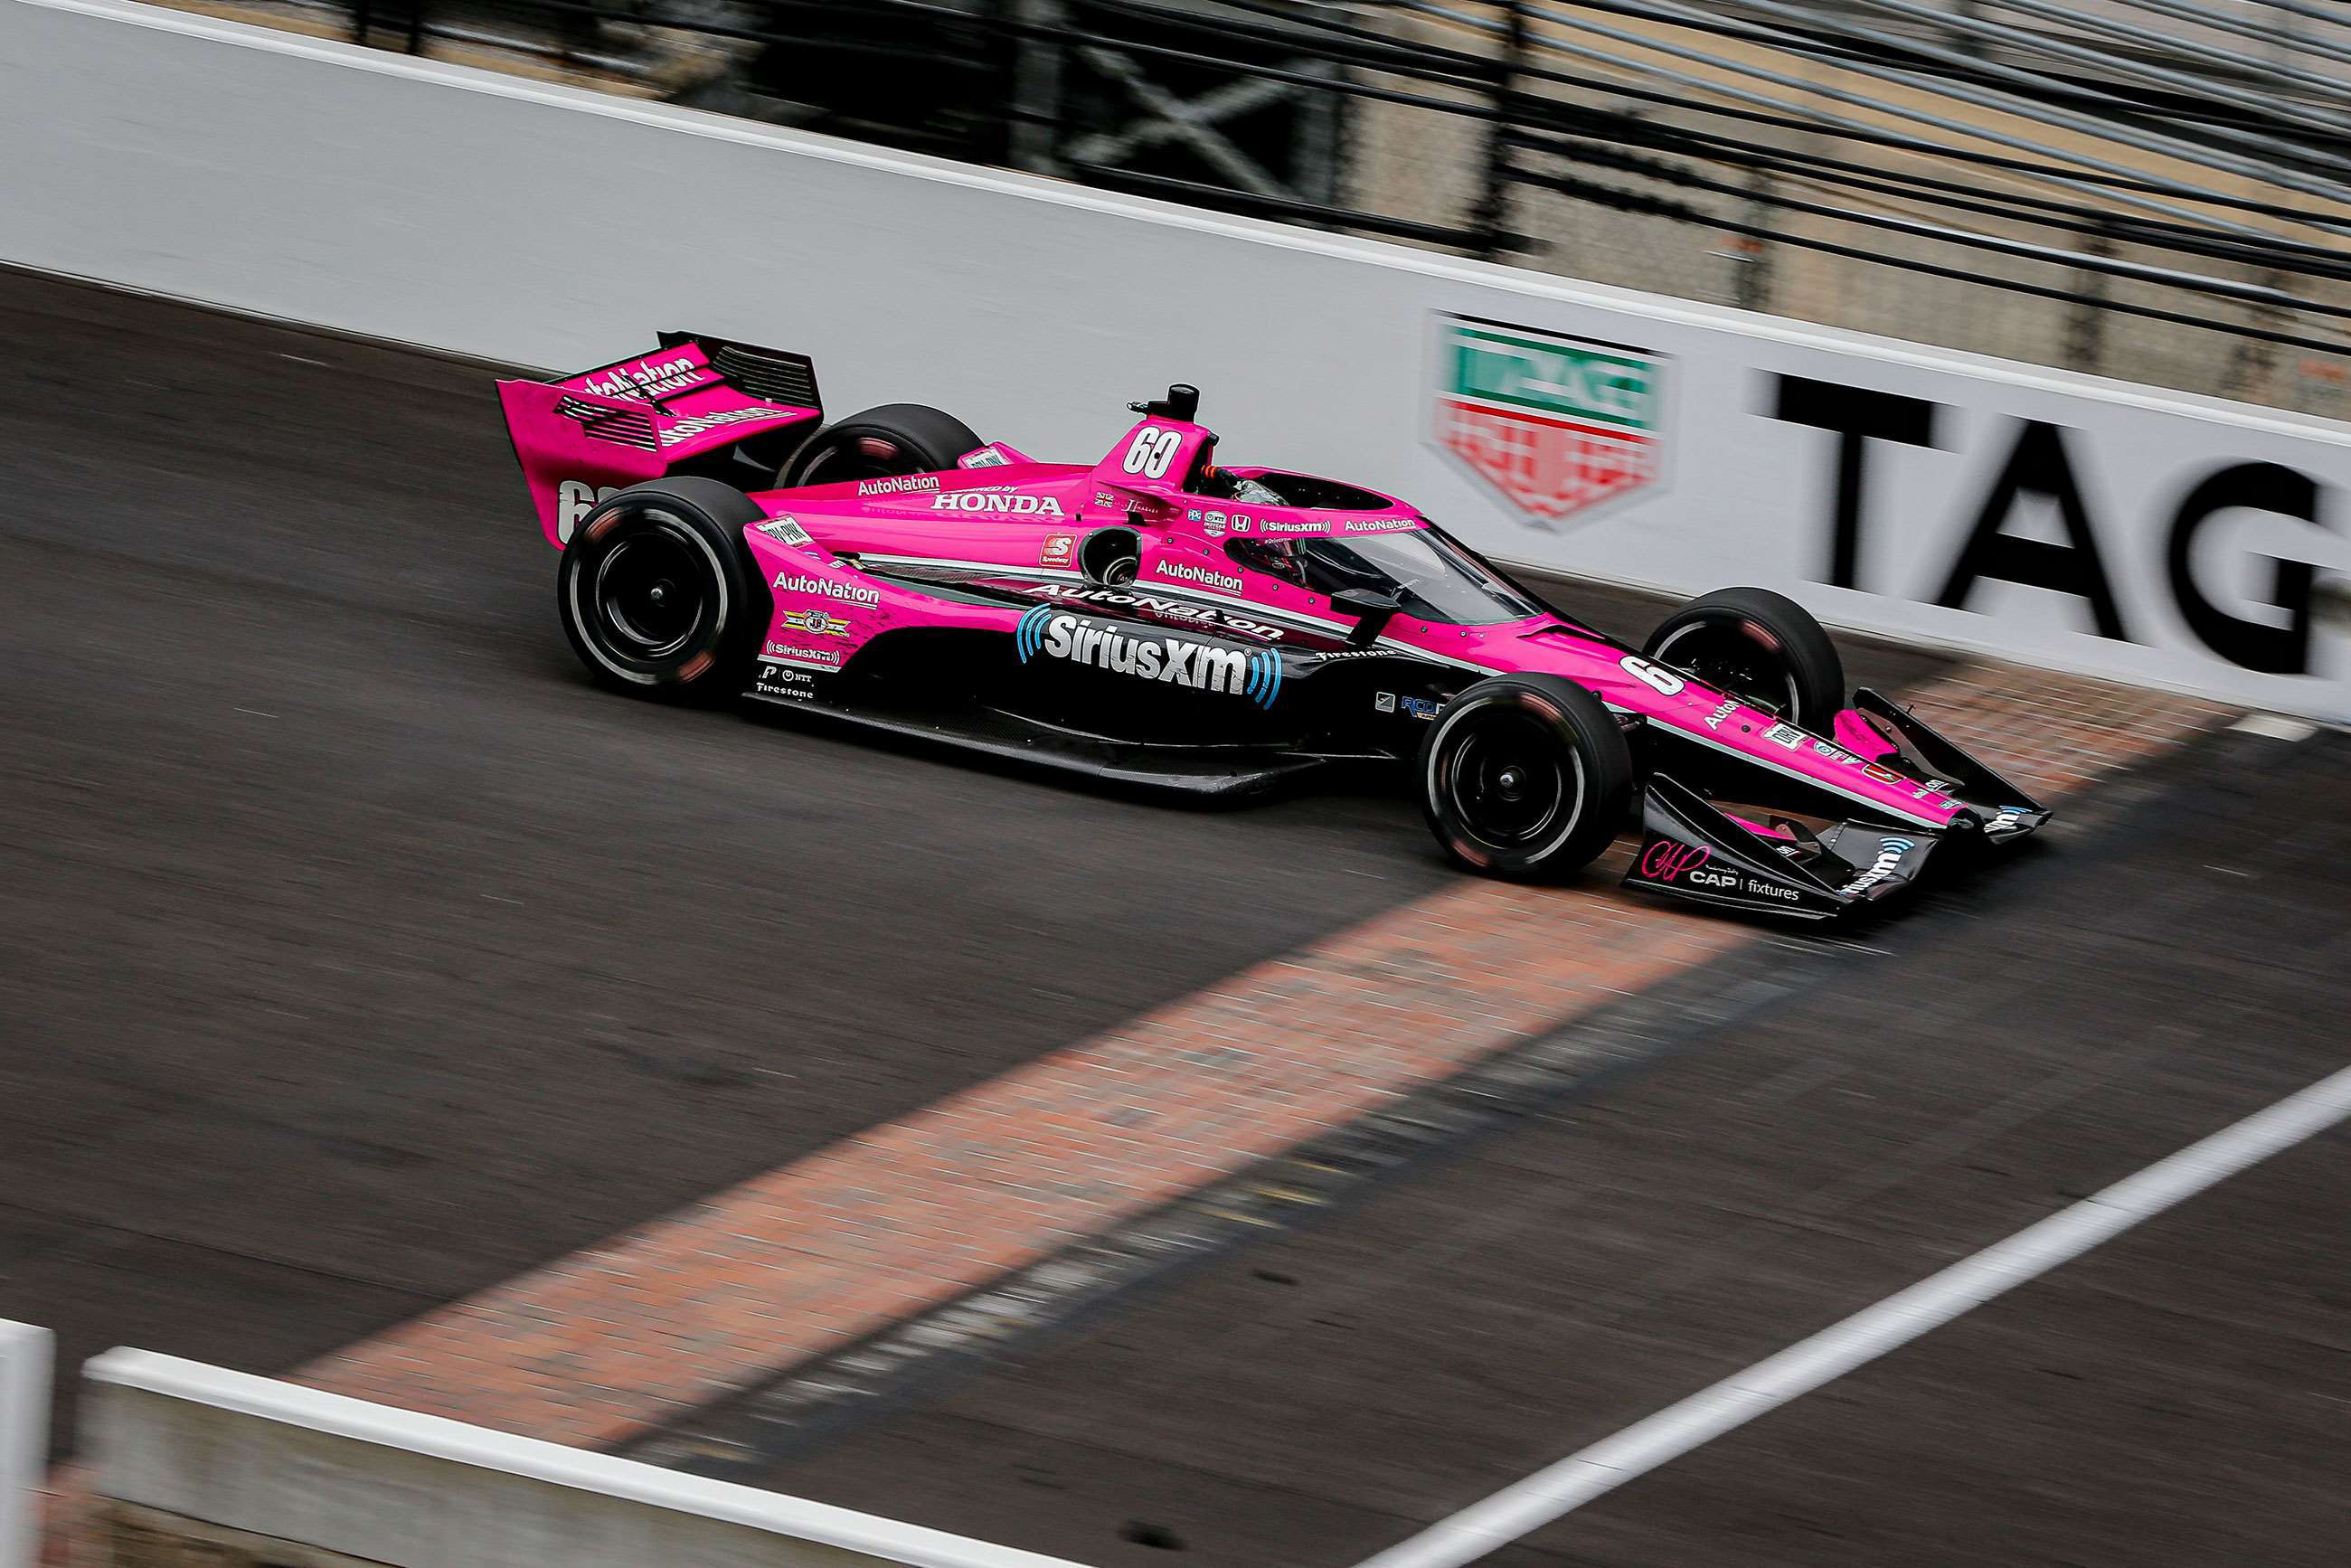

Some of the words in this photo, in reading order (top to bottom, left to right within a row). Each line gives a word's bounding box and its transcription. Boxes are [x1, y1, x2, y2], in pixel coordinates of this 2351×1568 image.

[585, 358, 705, 401] toNation
[658, 407, 784, 447] utoNation
[1122, 426, 1182, 479] 60
[858, 475, 939, 496] AutoNation
[558, 480, 621, 544] 6
[930, 493, 1065, 516] HONDA
[1344, 519, 1416, 532] AutoNation
[1759, 369, 2344, 676] TAG
[773, 571, 880, 604] AutoNation
[1156, 560, 1243, 590] AutoNation
[1022, 584, 1284, 638] AutoNation
[1316, 649, 1396, 661] Firestone
[756, 682, 814, 698] Firestone
[795, 674, 812, 682] NTT
[1689, 871, 1736, 887] CAP
[1748, 879, 1799, 901] fixtures
